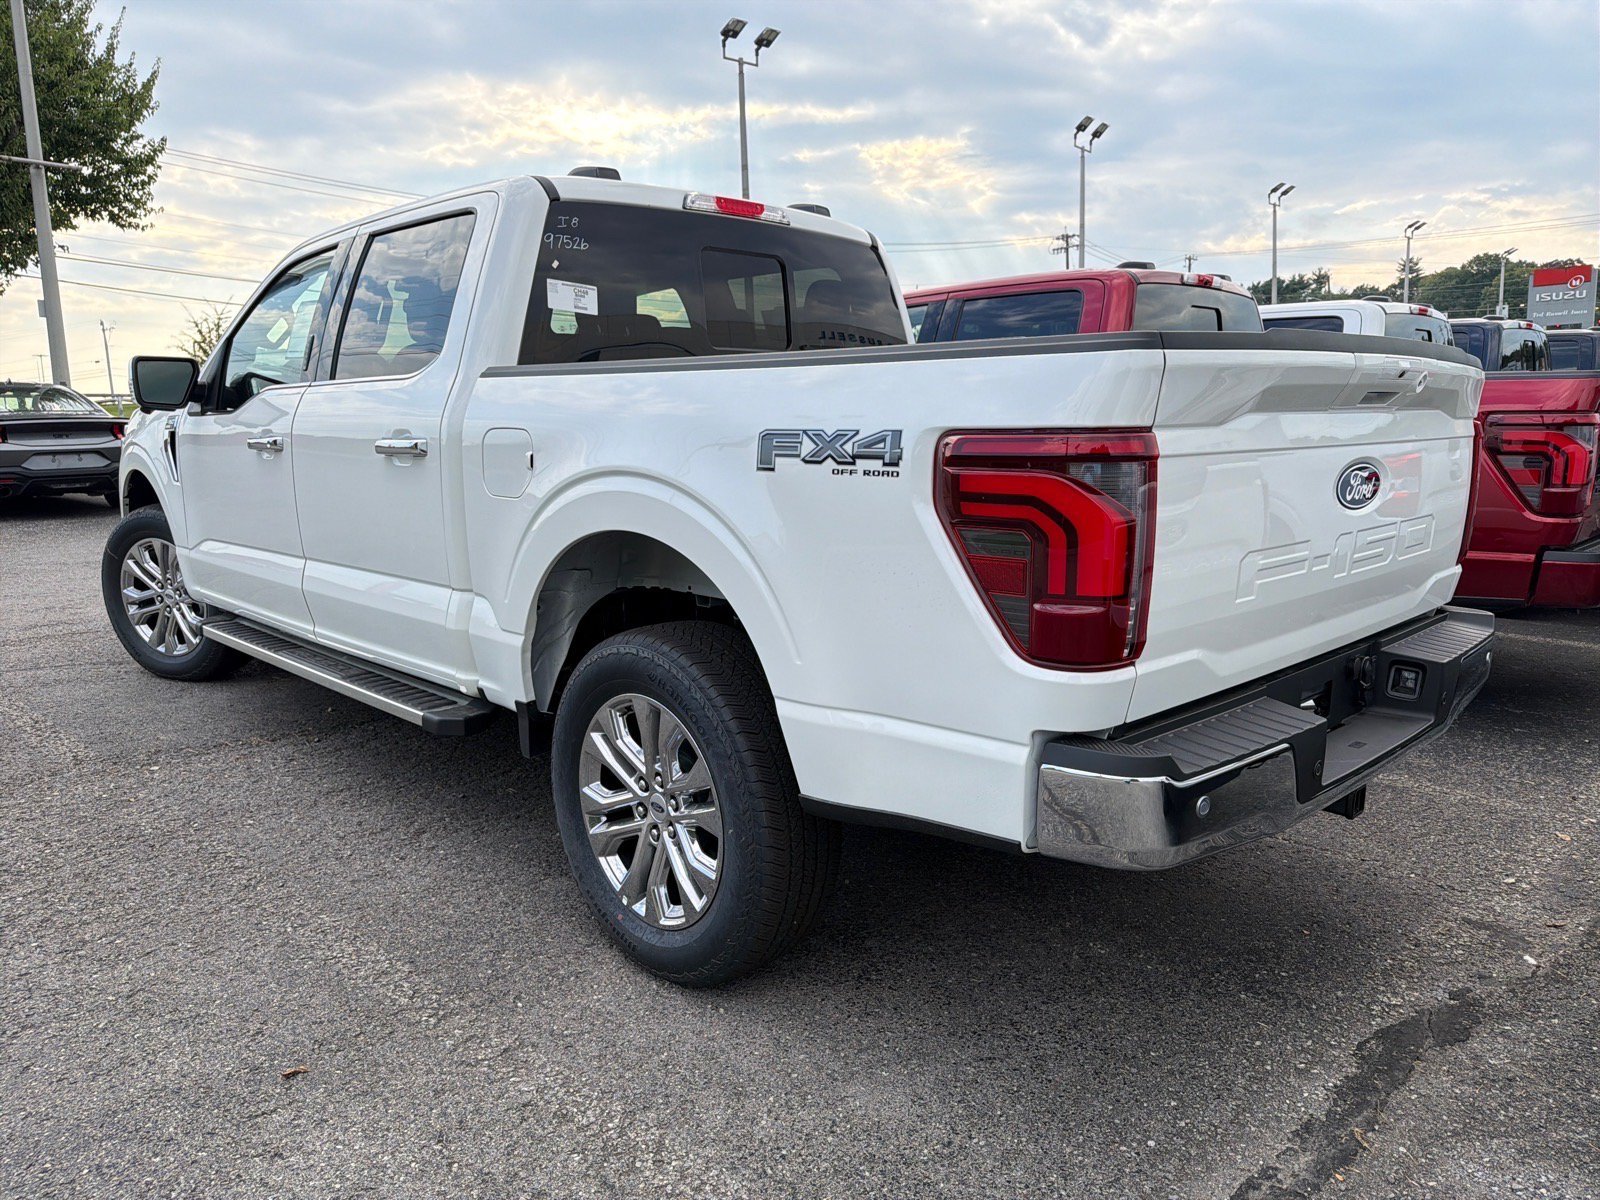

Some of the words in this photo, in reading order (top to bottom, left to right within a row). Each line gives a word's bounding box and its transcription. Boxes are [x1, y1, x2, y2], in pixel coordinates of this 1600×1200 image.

[543, 232, 590, 250] 97526
[1535, 289, 1587, 302] ISUZU
[756, 428, 903, 472] FX4
[831, 468, 858, 476] OFF
[862, 469, 900, 478] ROAD
[1344, 468, 1379, 502] Ford
[1235, 513, 1436, 604] F-150
